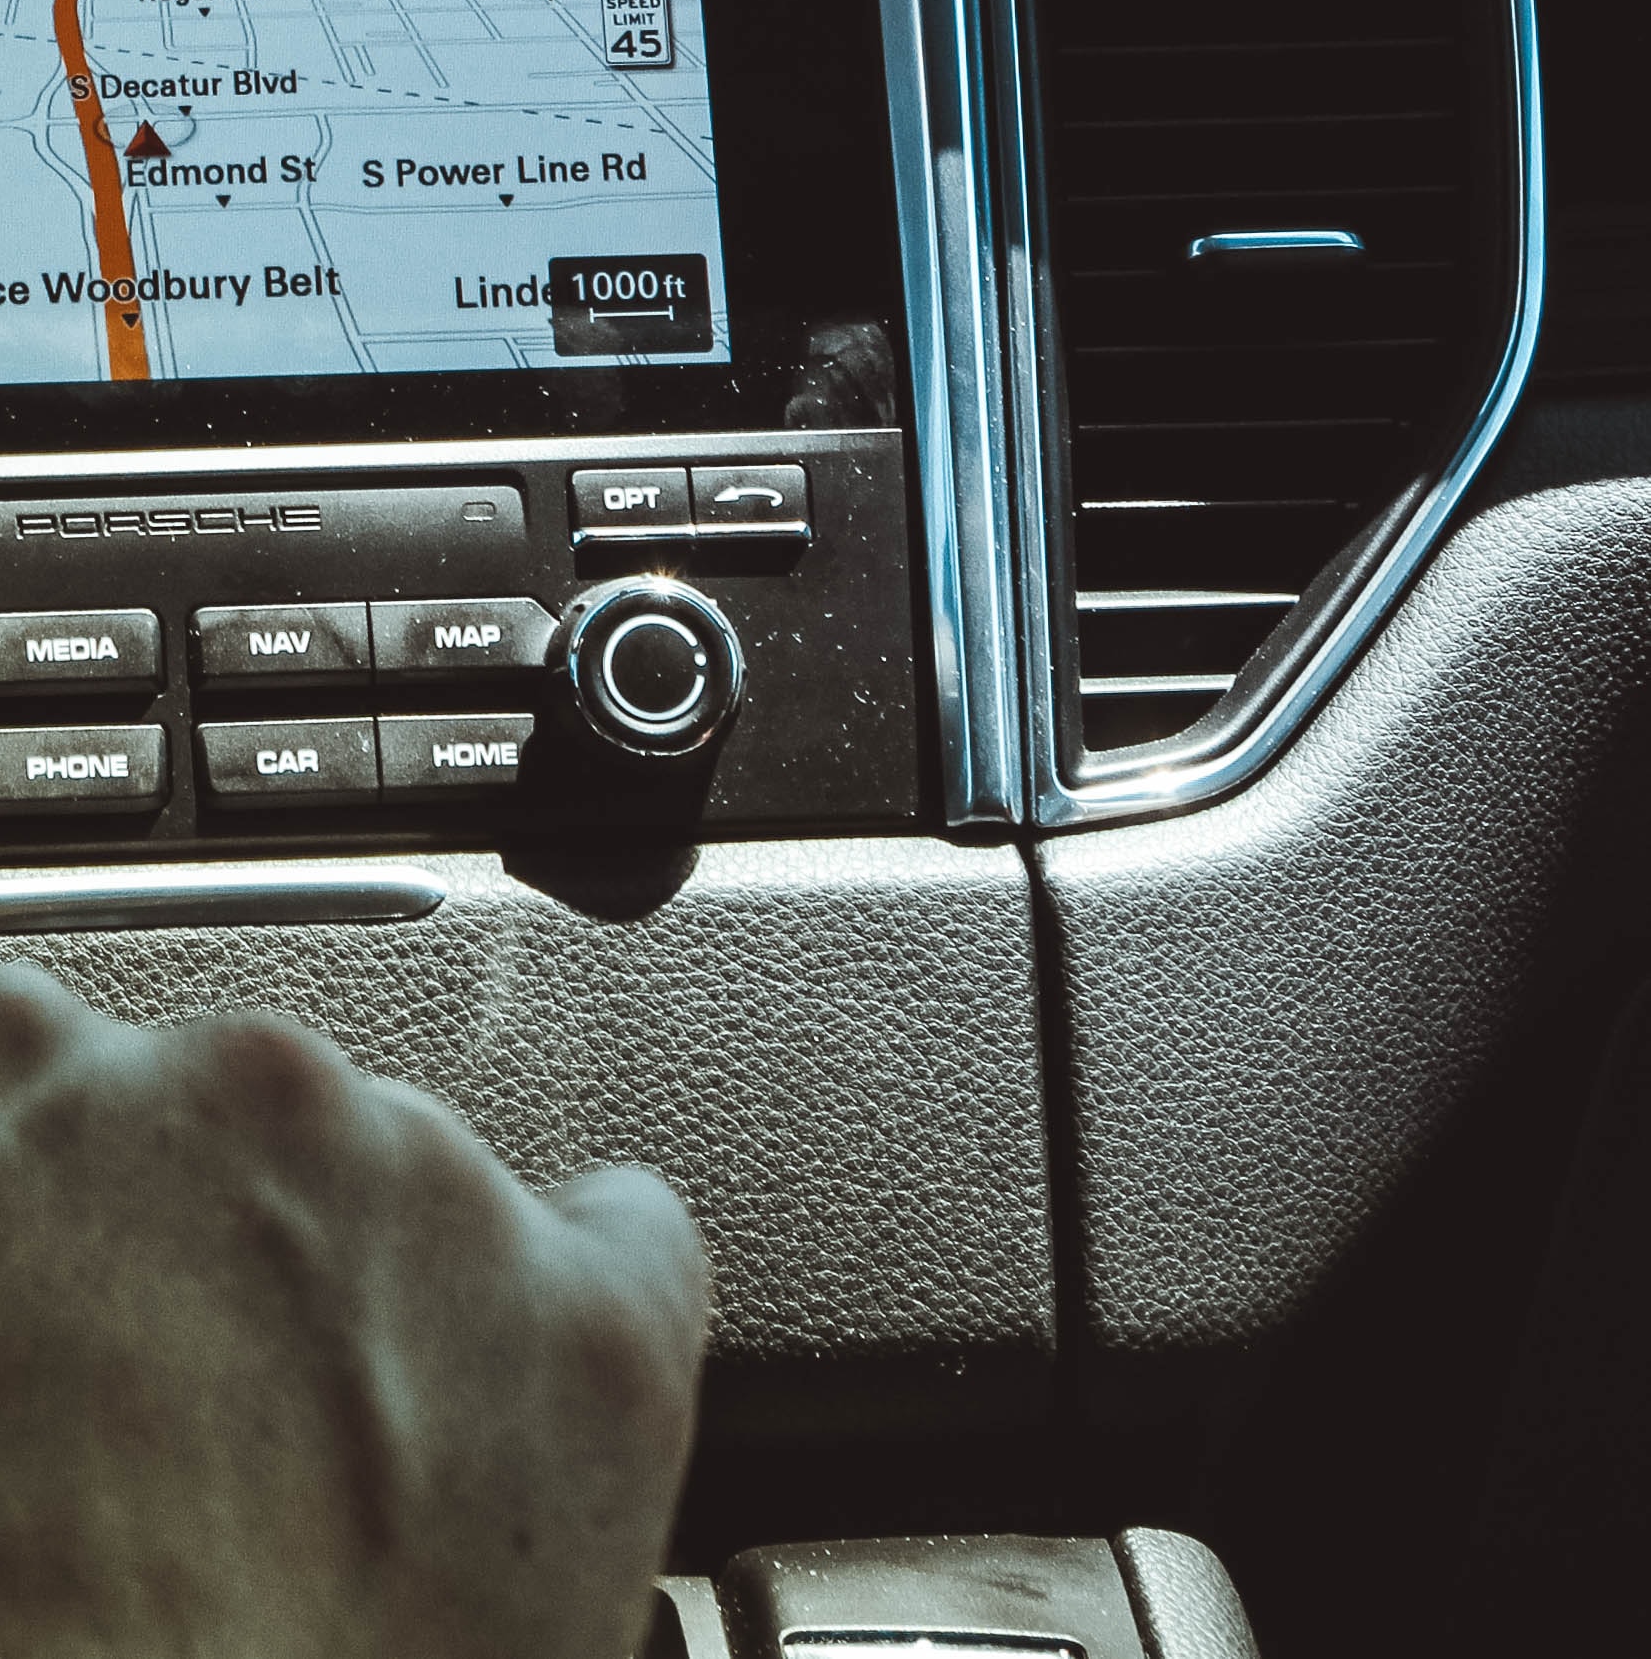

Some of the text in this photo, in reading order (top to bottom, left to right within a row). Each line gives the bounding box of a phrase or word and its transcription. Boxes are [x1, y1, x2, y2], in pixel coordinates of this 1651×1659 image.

[614, 12, 655, 25] LIMIT
[611, 31, 661, 58] 45
[71, 71, 298, 99] S Decatur Blvd
[128, 157, 317, 188] Edmond St
[362, 153, 646, 188] S Power Line Rd
[42, 269, 250, 309] Woodbury
[265, 265, 341, 297] Belt
[572, 272, 686, 300] 1000 ft
[605, 487, 661, 510] OPT
[16, 505, 322, 539] PORSCHE
[248, 631, 311, 655] NAV
[435, 625, 501, 648] MAP
[27, 637, 118, 662] MEDIA
[256, 749, 319, 774] CAR
[432, 742, 519, 767] HOME
[27, 755, 129, 780] PHONE
